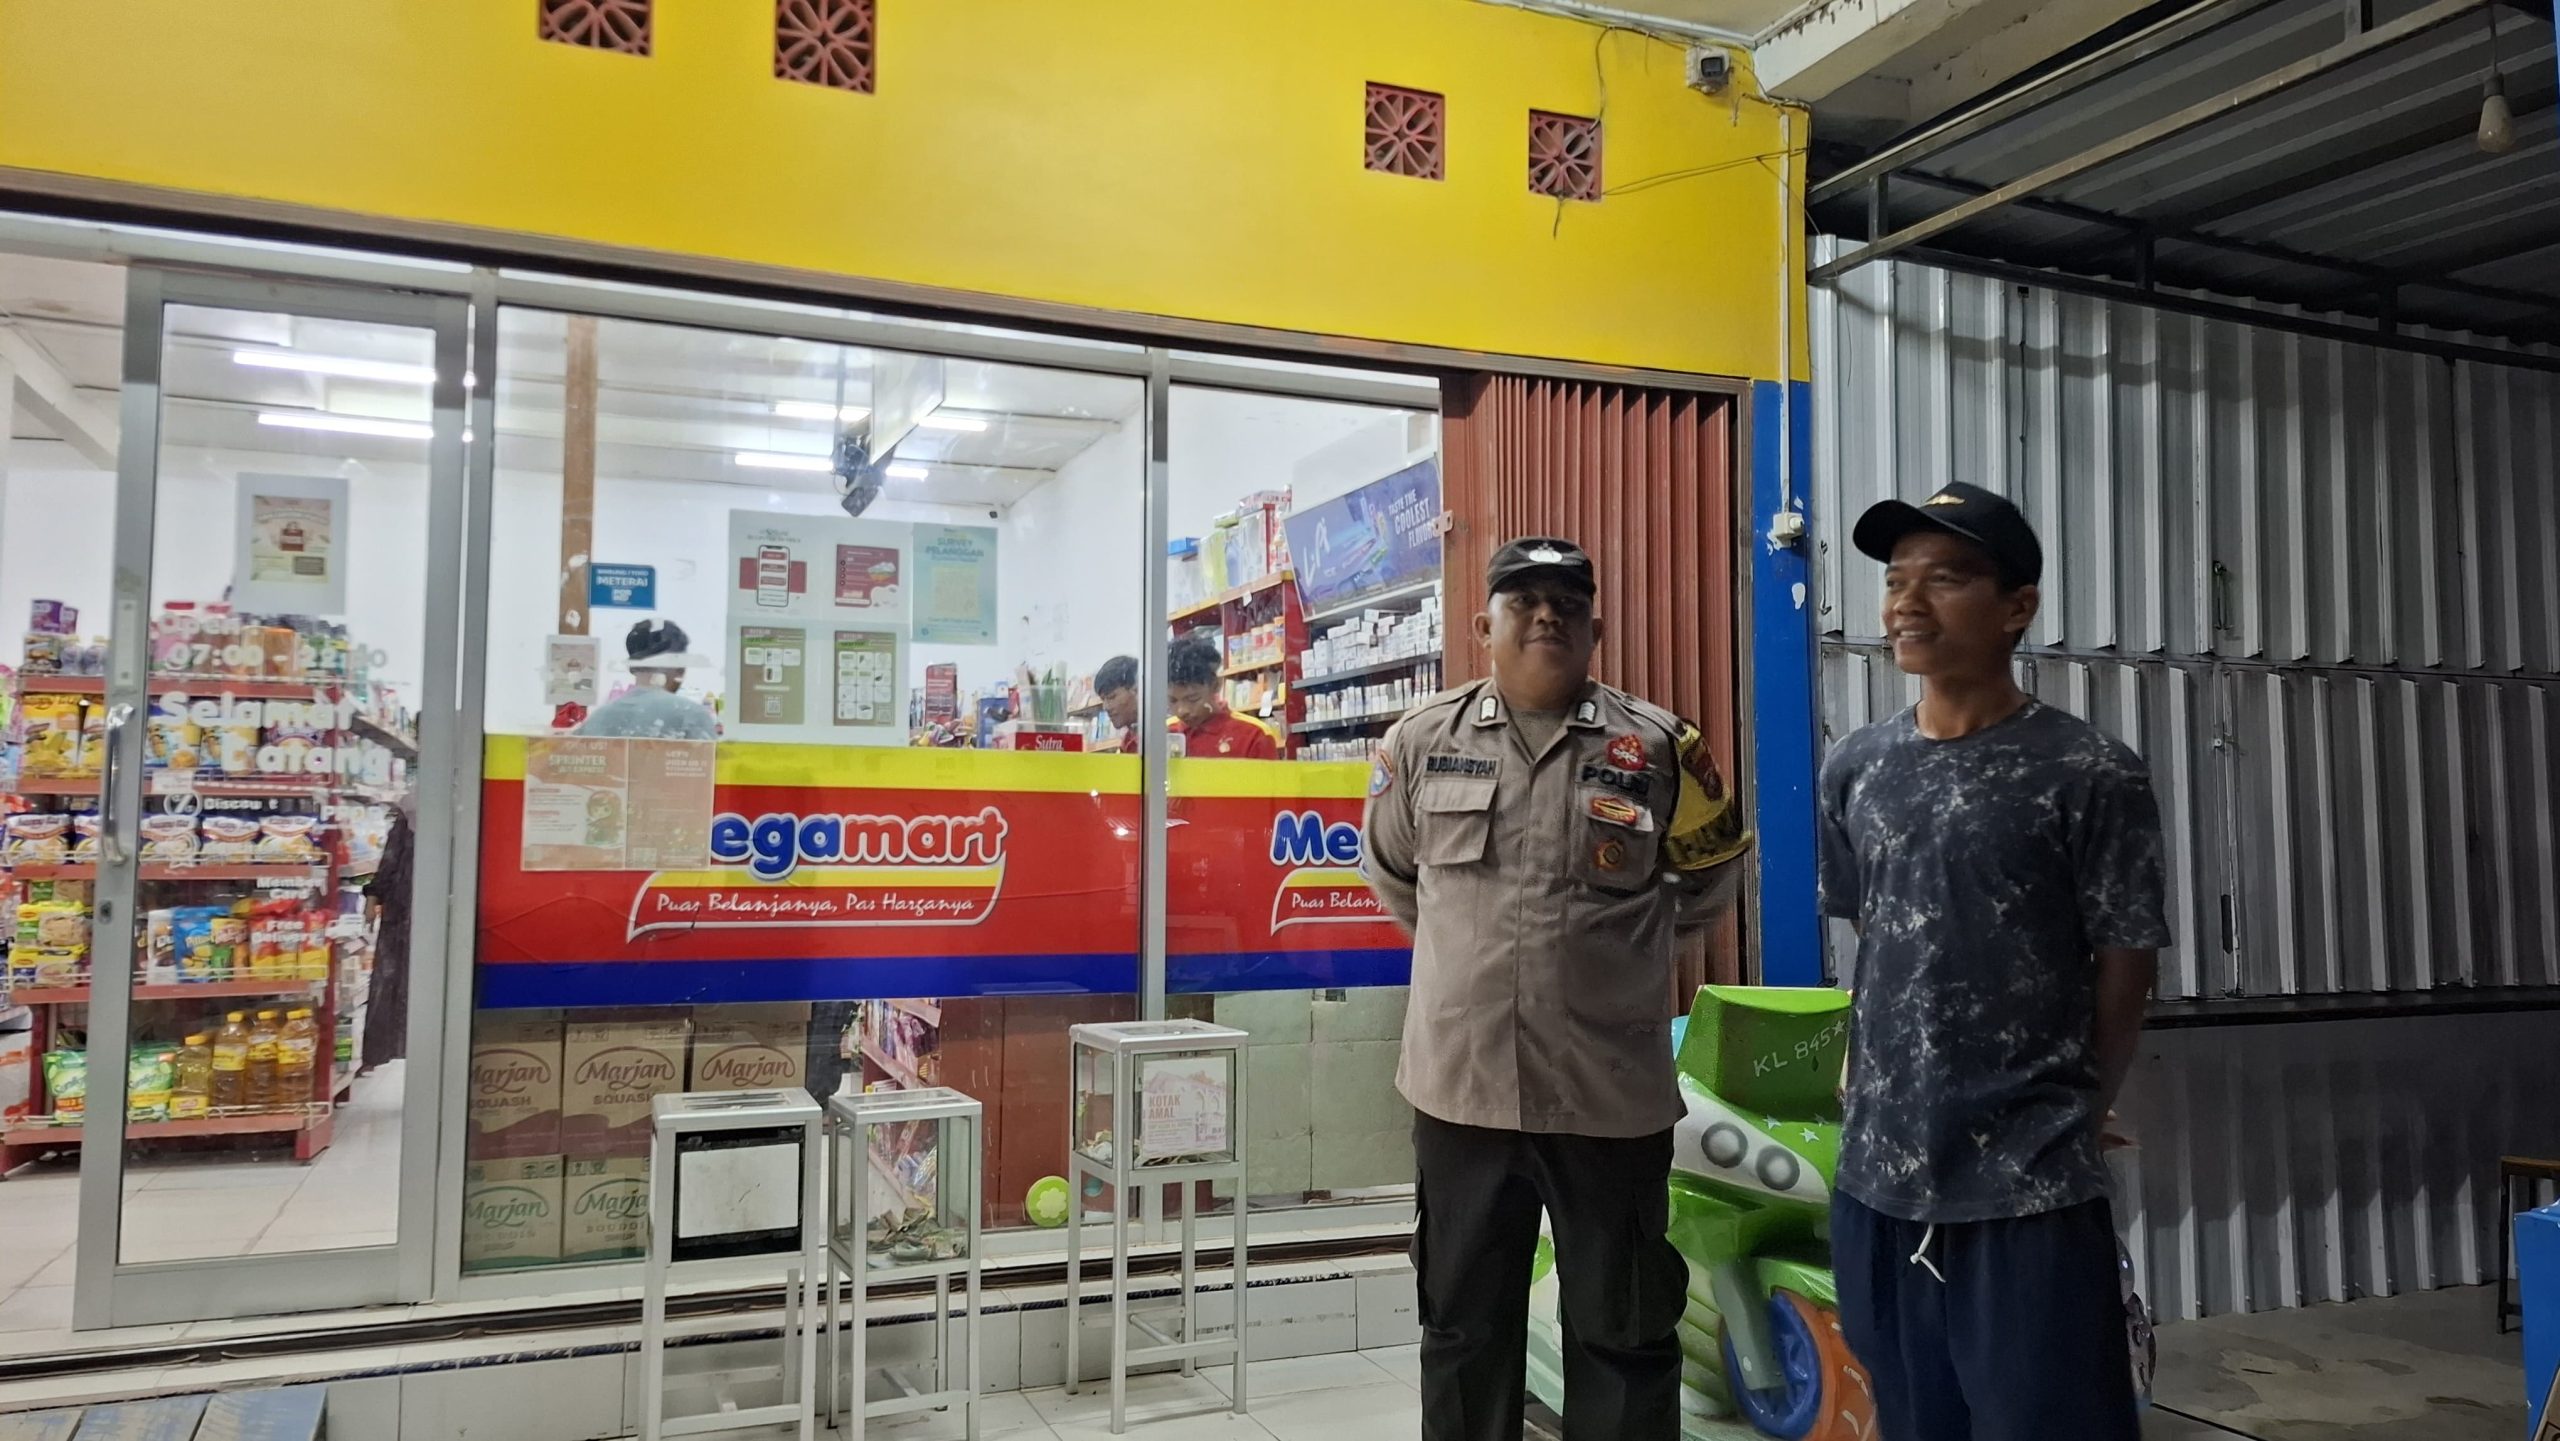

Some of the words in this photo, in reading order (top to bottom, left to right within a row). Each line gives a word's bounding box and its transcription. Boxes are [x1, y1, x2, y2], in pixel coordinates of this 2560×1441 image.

[1394, 497, 1430, 535] COOLEST
[1408, 519, 1436, 549] FLAVOR
[159, 691, 354, 730] Selamat
[1035, 734, 1064, 750] Sutra
[204, 797, 279, 811] Discout
[711, 805, 1008, 882] egamart
[1269, 809, 1371, 880] Me
[656, 892, 702, 912] Puas
[707, 892, 838, 918] Belanjanya,
[845, 893, 877, 911] Pas
[881, 893, 975, 916] Harganya
[1291, 891, 1325, 909] Puas
[1329, 891, 1386, 913] Belanj
[1753, 1052, 1788, 1078] KL
[1794, 1027, 1831, 1061] 845
[574, 1055, 676, 1090] Marjan
[702, 1054, 796, 1087] Marjan
[1149, 1095, 1180, 1107] KOTAK
[1149, 1107, 1176, 1120] AMAL
[574, 1188, 647, 1220] Marja
